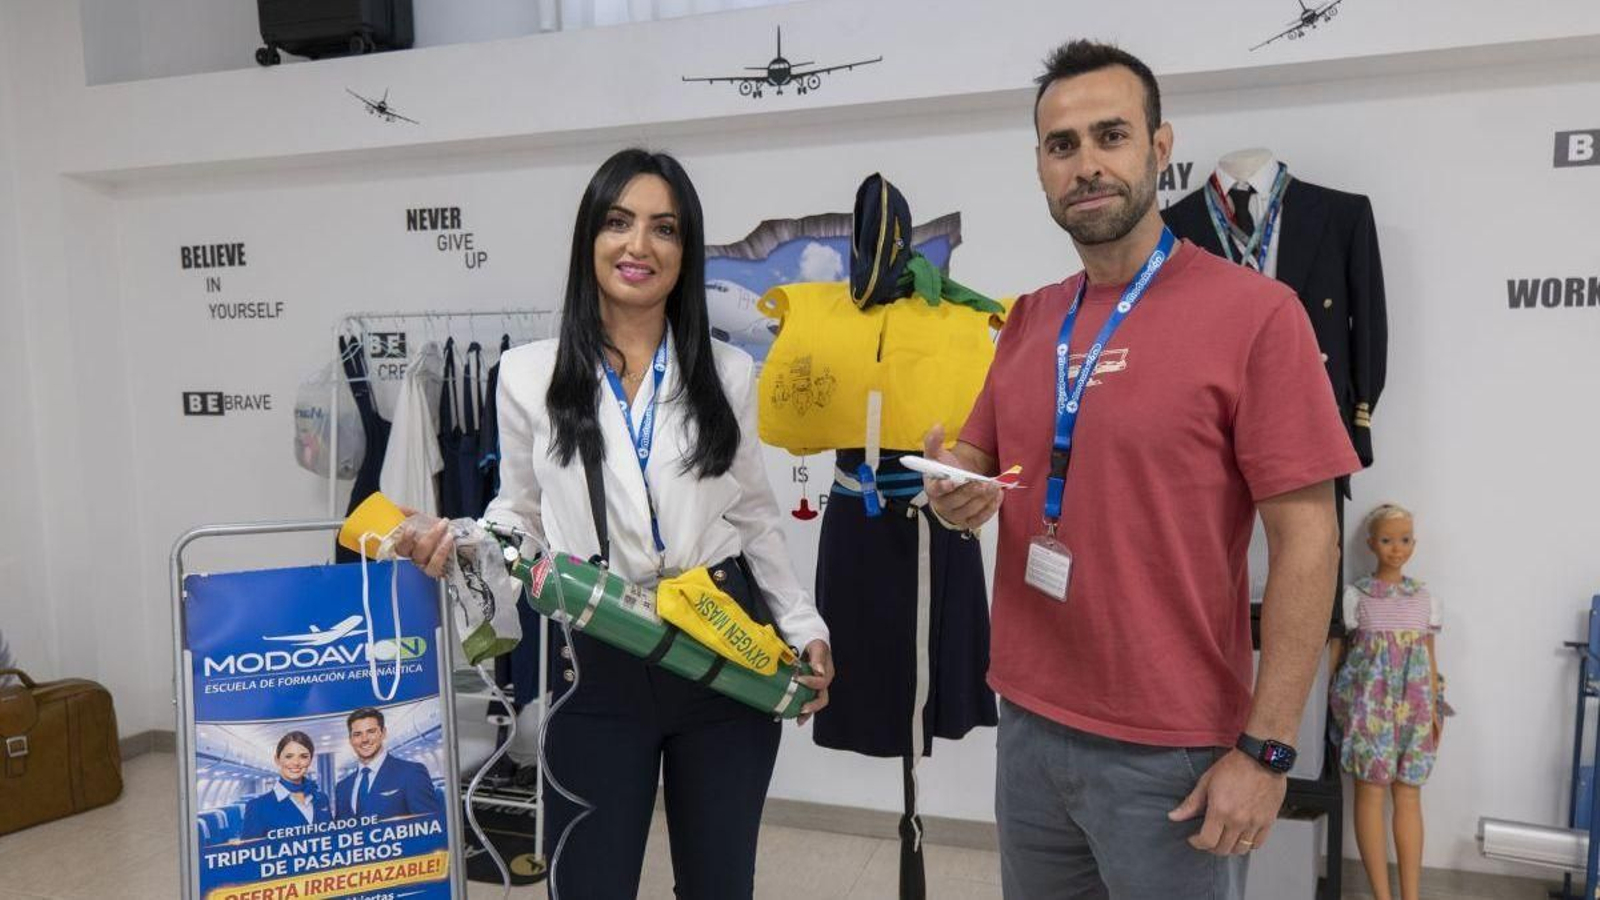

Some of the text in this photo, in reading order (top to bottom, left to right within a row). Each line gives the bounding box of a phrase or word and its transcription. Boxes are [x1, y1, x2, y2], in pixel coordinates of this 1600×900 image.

[406, 206, 462, 231] NEVER
[437, 232, 474, 251] GIVE
[180, 242, 247, 269] BELIEVE
[465, 250, 488, 269] UP
[206, 277, 221, 292] IN
[209, 301, 284, 320] YOURSELF
[369, 334, 403, 356] BE
[187, 393, 272, 413] BE BRAVE
[792, 466, 809, 483] IS
[694, 593, 731, 631] MASK
[723, 622, 770, 670] OXYGEN
[205, 681, 257, 694] ESCUELA
[260, 679, 276, 689] DE
[267, 814, 378, 840] CERTIFICADO DE
[204, 819, 442, 869] TRIPULANTE DE CABINA
[260, 842, 403, 878] DE PASAJEROS
[304, 858, 440, 896] IRRECHAZABLE!
